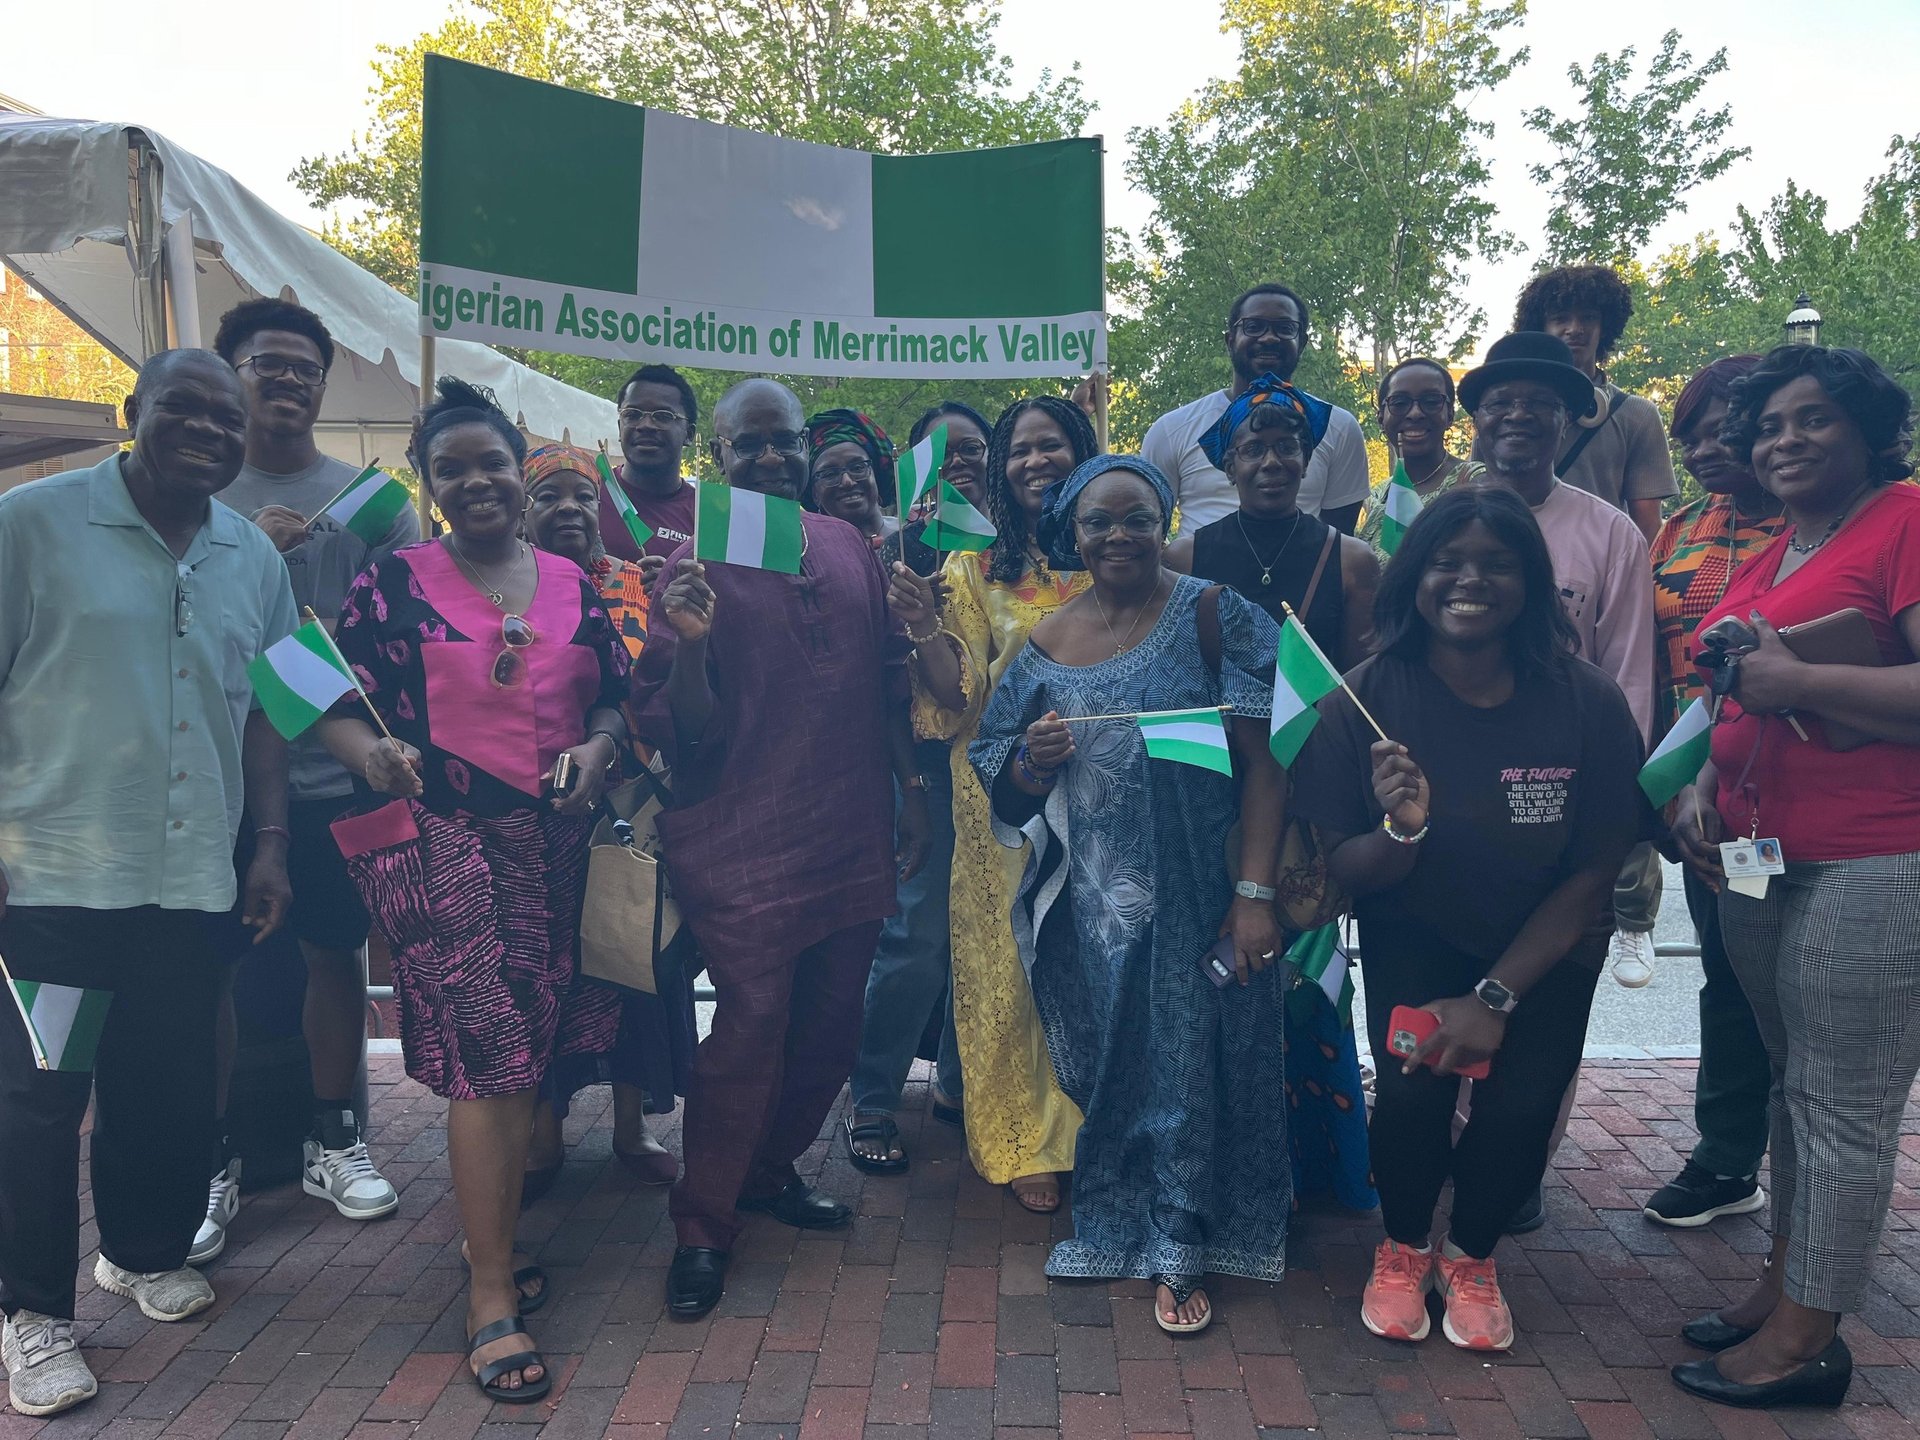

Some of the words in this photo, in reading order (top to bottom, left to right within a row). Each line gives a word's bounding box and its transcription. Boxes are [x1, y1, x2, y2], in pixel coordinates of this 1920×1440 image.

[422, 270, 543, 332] igerian
[555, 293, 757, 355] Association
[768, 319, 801, 358] of
[813, 321, 989, 363] Merrimack
[998, 323, 1096, 370] Valley
[1501, 768, 1526, 782] THE
[1527, 767, 1576, 782] FUTURE
[1506, 792, 1524, 800] THE
[1556, 790, 1568, 798] US
[1509, 800, 1533, 808] STILL
[1534, 798, 1564, 807] WILLING
[1513, 808, 1526, 816] TO
[1546, 806, 1560, 814] OUR
[1511, 816, 1542, 824] HANDS
[1542, 814, 1563, 822] DIRTY
